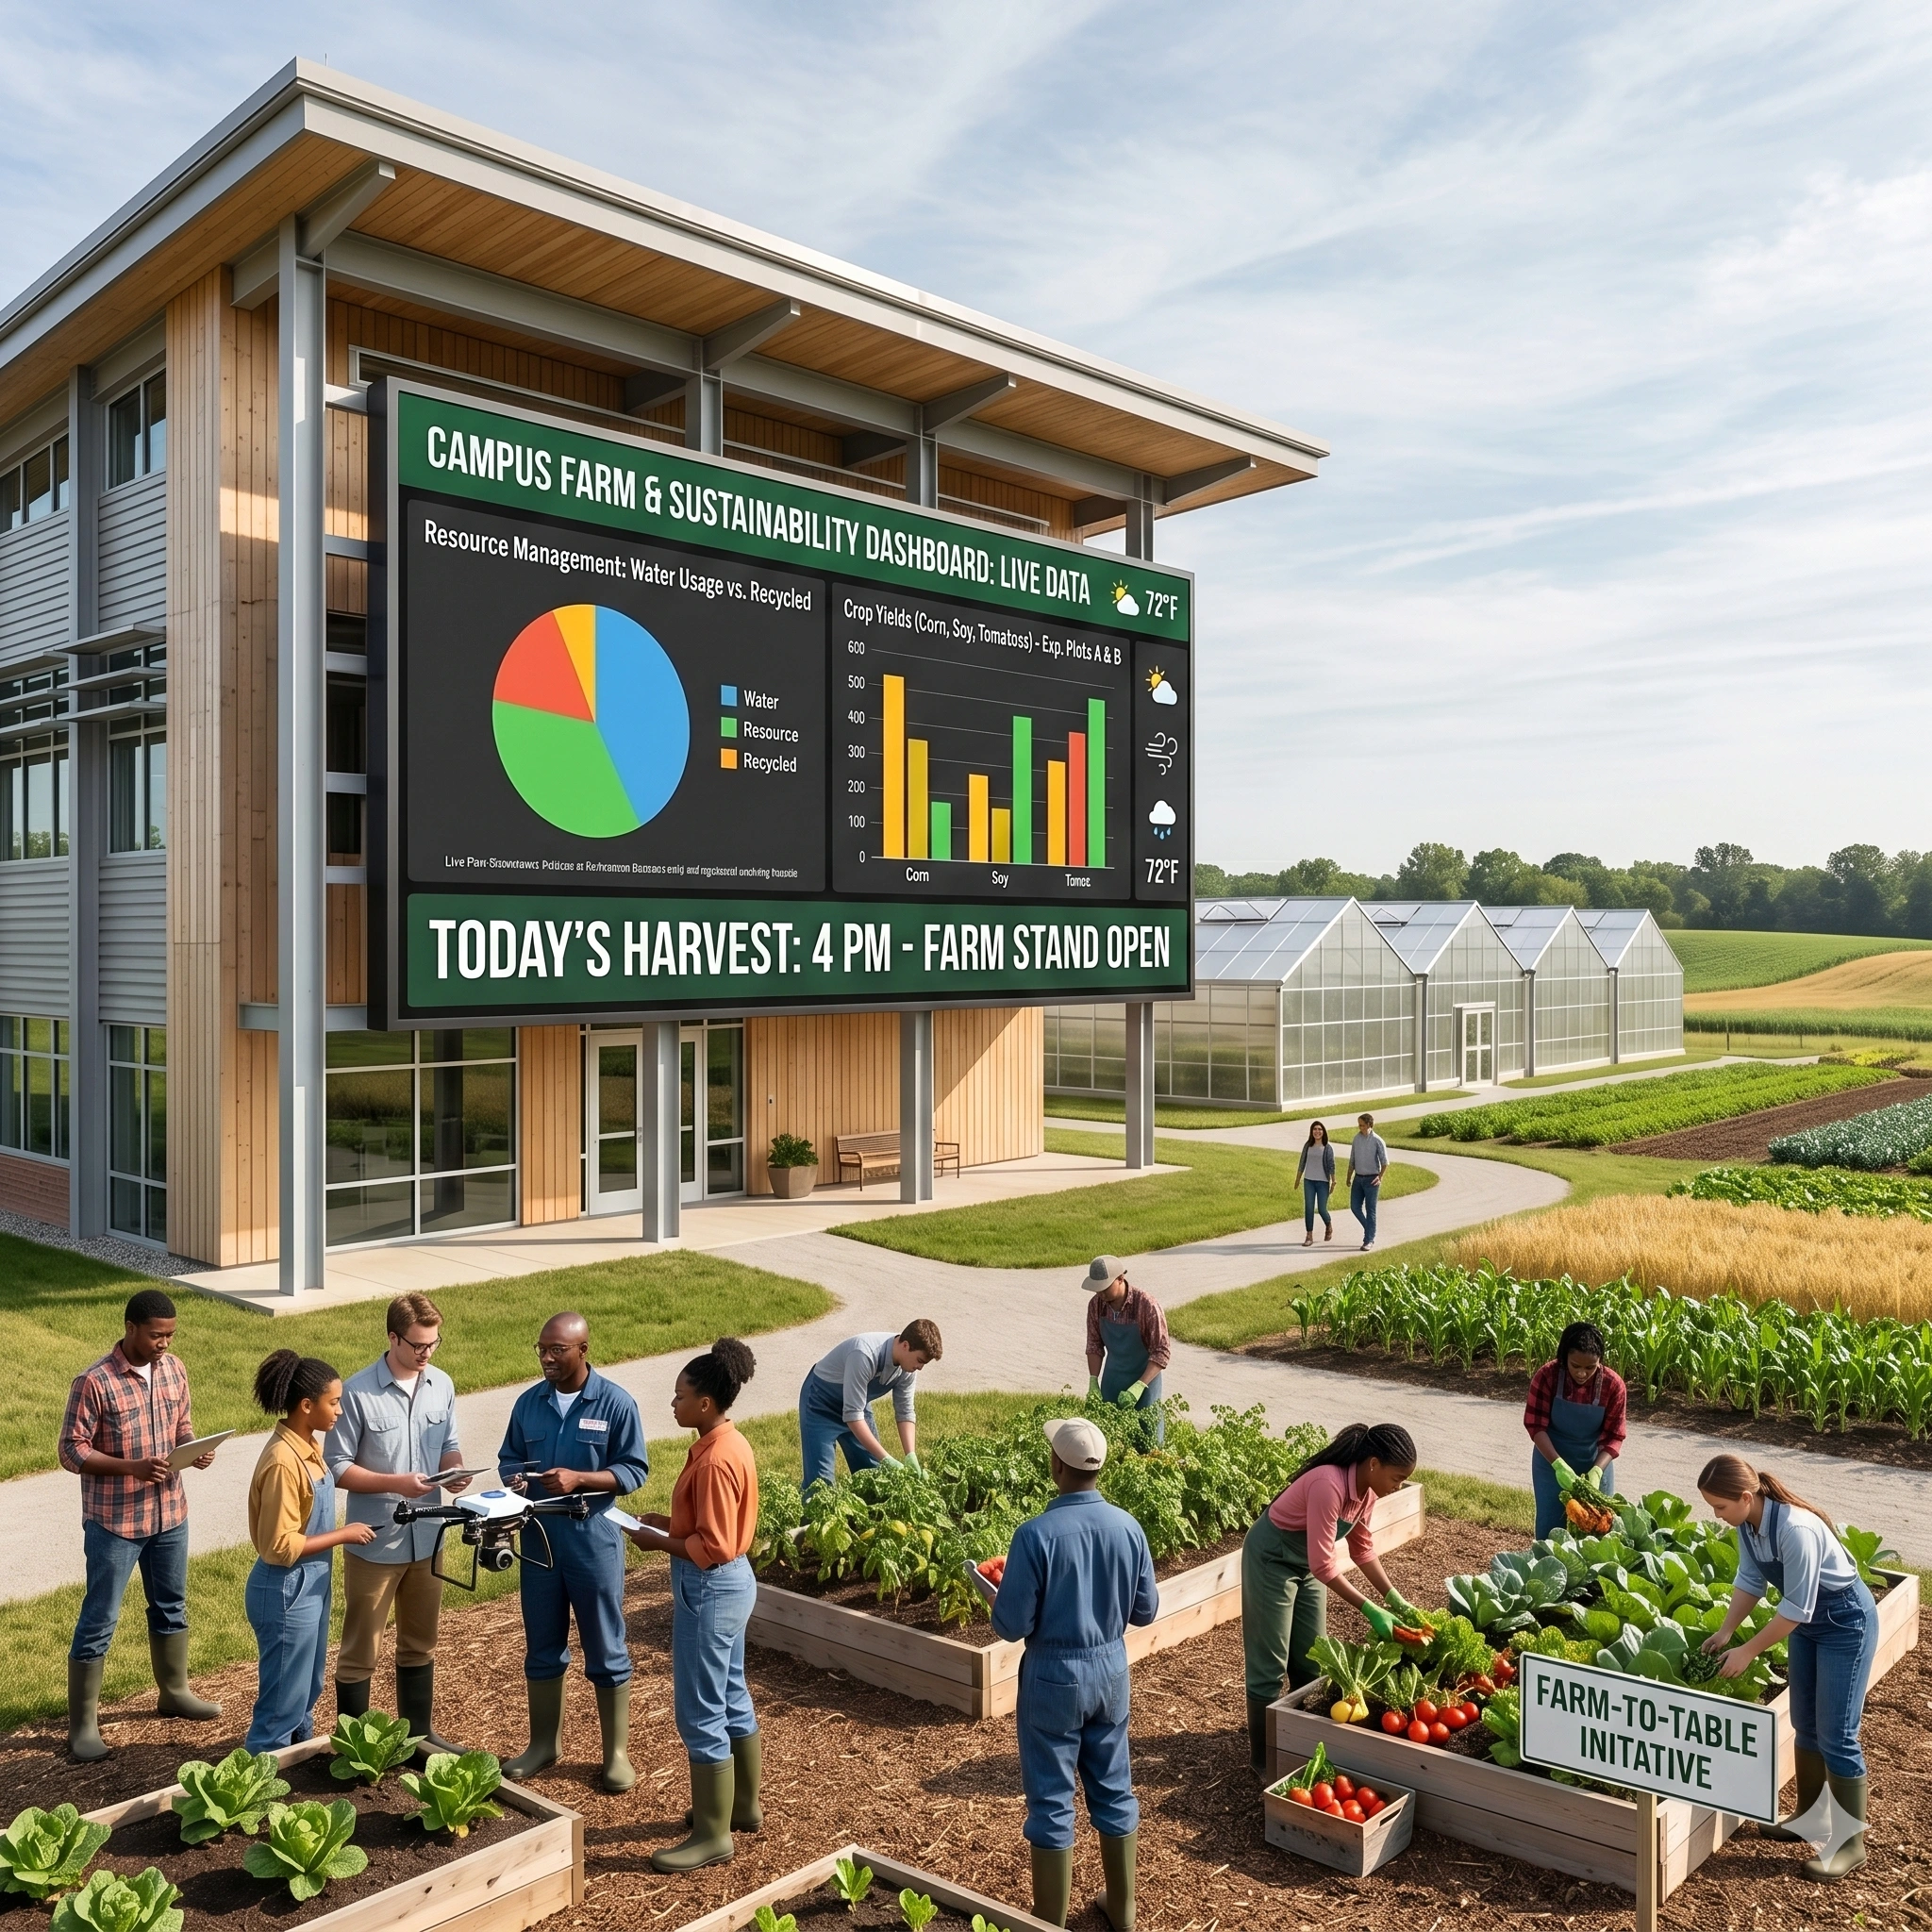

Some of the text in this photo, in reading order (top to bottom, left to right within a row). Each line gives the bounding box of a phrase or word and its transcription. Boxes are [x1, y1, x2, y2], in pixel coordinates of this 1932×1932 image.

[426, 425, 1091, 606] CAMPUS FARM & SUSTAINABILITY DASHBOARD: LIVE DATA
[424, 519, 812, 612] Resource Management: Water Usage vs. Recycled
[1144, 590, 1179, 622] 72°F
[843, 598, 874, 626] Crop
[874, 603, 913, 629] Yields
[913, 609, 951, 639] (Corn,
[952, 617, 976, 644] Soy,
[977, 623, 1033, 654] Tomatoss)
[1041, 634, 1065, 659] Exp.
[1066, 639, 1092, 660] Plots
[1093, 644, 1103, 662] A
[1103, 645, 1112, 664] &
[1113, 647, 1123, 666] B
[847, 640, 866, 656] 600
[847, 675, 866, 690] 500
[742, 689, 780, 710] Water
[847, 709, 866, 724] 400
[742, 720, 800, 743] Resource
[742, 751, 798, 774] Recycled
[847, 744, 866, 759] 300
[847, 779, 866, 793] 200
[847, 814, 866, 828] 100
[858, 850, 866, 863] 0
[991, 870, 1009, 889] Soy
[1144, 858, 1179, 884] 72°F
[428, 919, 1170, 979] TODAY'S HARVEST: 4 PM - FARM STAND OPEN
[1537, 1674, 1758, 1758] FARM-TO-TABLE
[1580, 1724, 1713, 1790] INITATIVE
